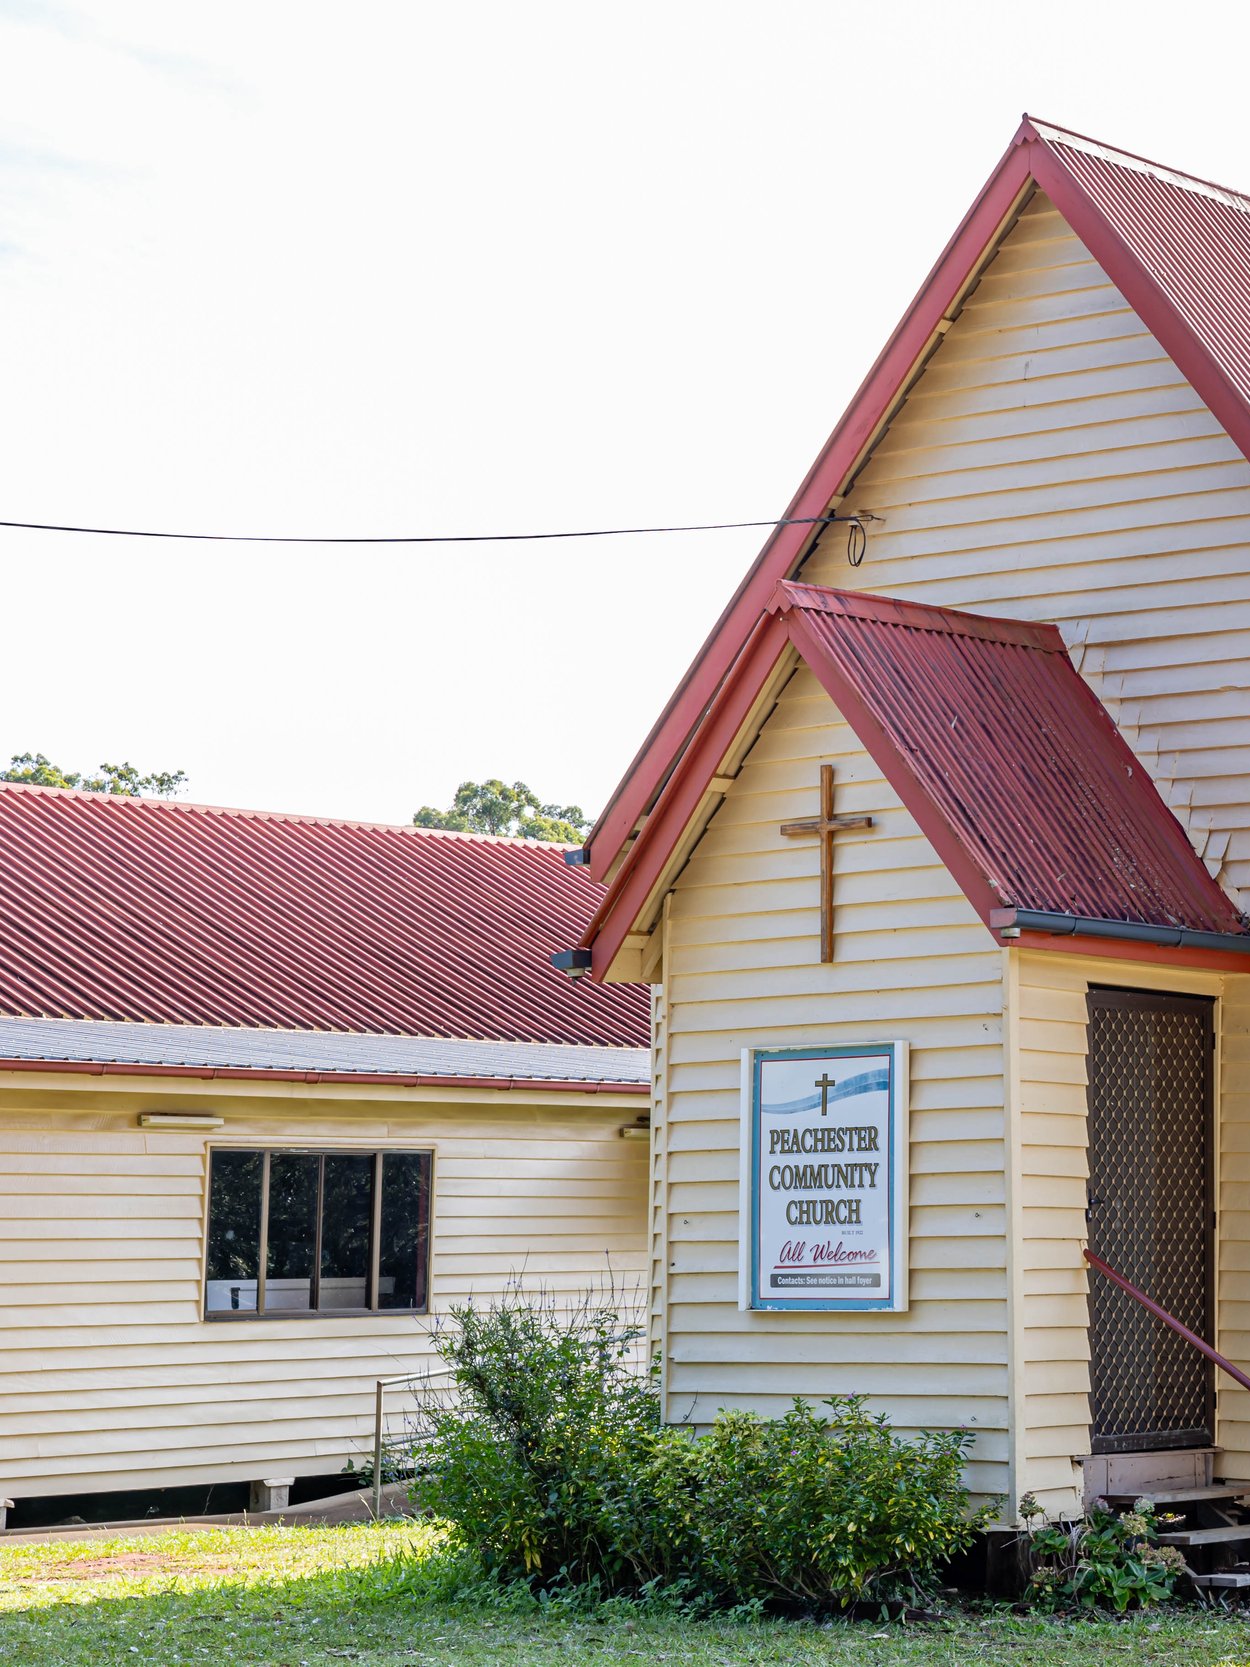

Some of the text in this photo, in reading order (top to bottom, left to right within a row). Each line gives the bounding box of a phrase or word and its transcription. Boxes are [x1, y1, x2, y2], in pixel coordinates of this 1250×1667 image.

[769, 1126, 880, 1155] PEACHESTER
[769, 1163, 880, 1191] COMMUNITY
[786, 1199, 862, 1226] CHURCH
[780, 1240, 877, 1263] All Welcome
[777, 1276, 873, 1287] Contacts: See notice in hall foyer
